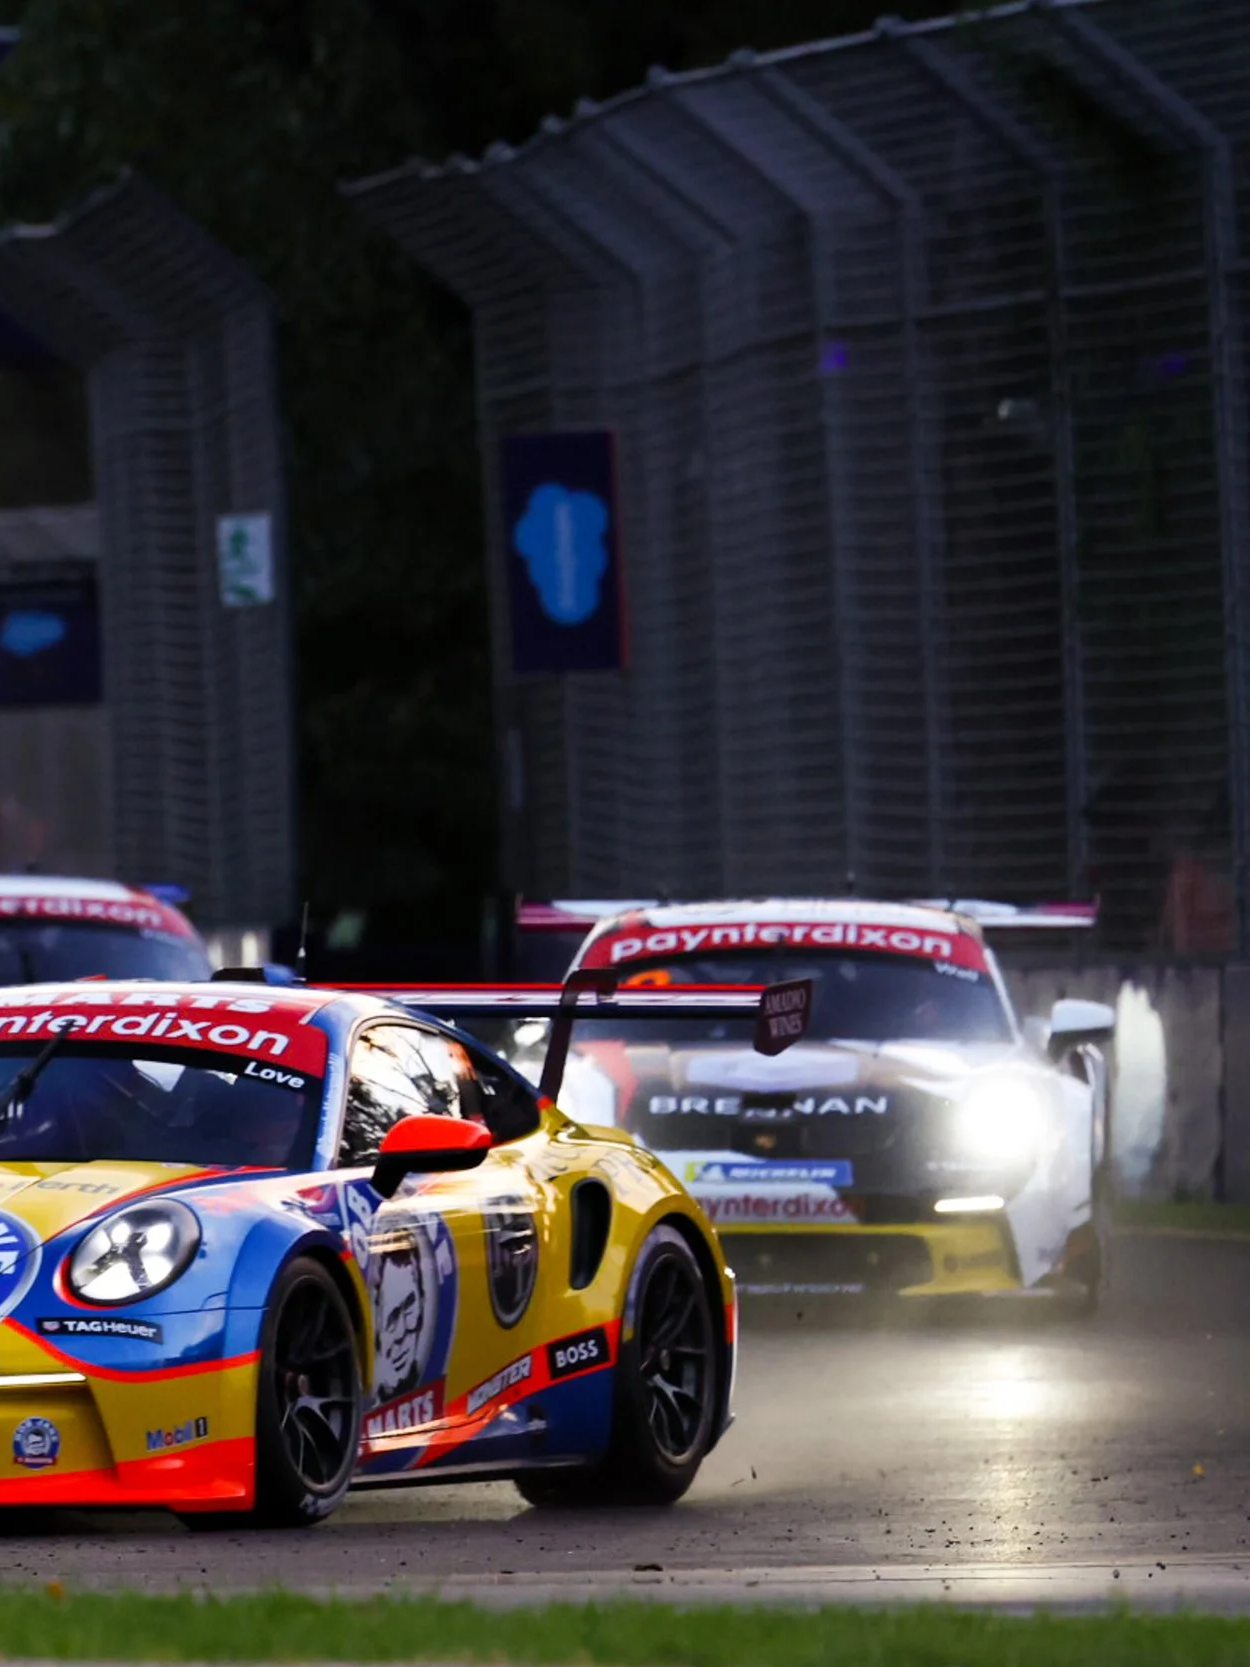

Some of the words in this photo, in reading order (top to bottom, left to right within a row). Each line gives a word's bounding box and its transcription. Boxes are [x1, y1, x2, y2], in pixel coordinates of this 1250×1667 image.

[610, 921, 954, 963] paynterdixon
[768, 1013, 803, 1038] WINES
[243, 1060, 306, 1089] Love
[697, 1194, 867, 1221] ynterdixon
[555, 1339, 599, 1368] BOSS
[146, 1420, 194, 1452] Mobil
